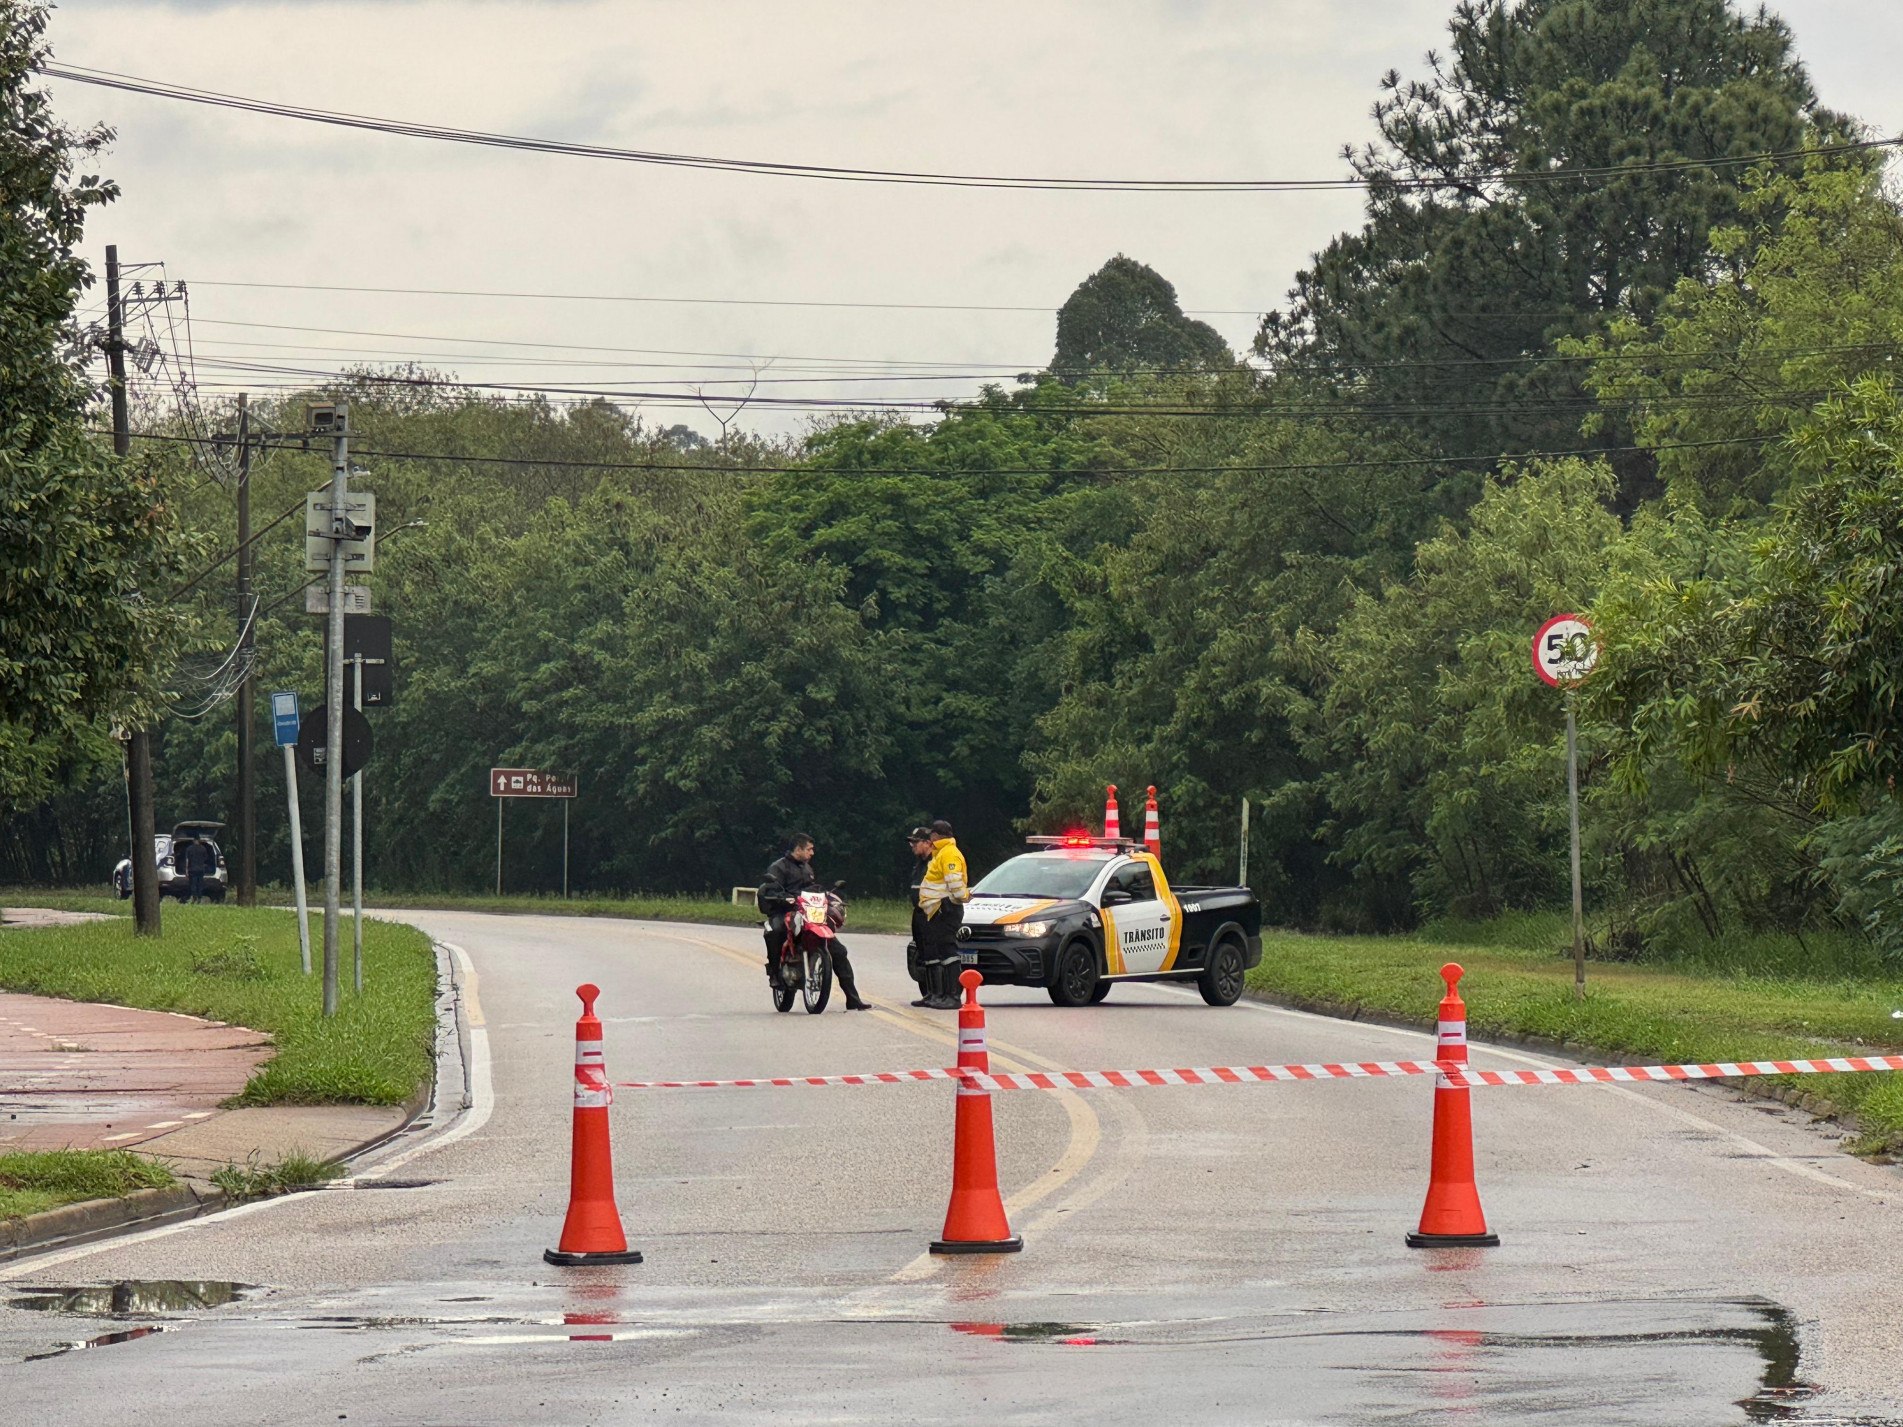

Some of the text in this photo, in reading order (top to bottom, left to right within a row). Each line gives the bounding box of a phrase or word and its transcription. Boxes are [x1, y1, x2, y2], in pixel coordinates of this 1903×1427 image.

[527, 773, 541, 783] Pq.
[527, 784, 541, 792] das
[1124, 927, 1164, 943] TRÂNSITO
